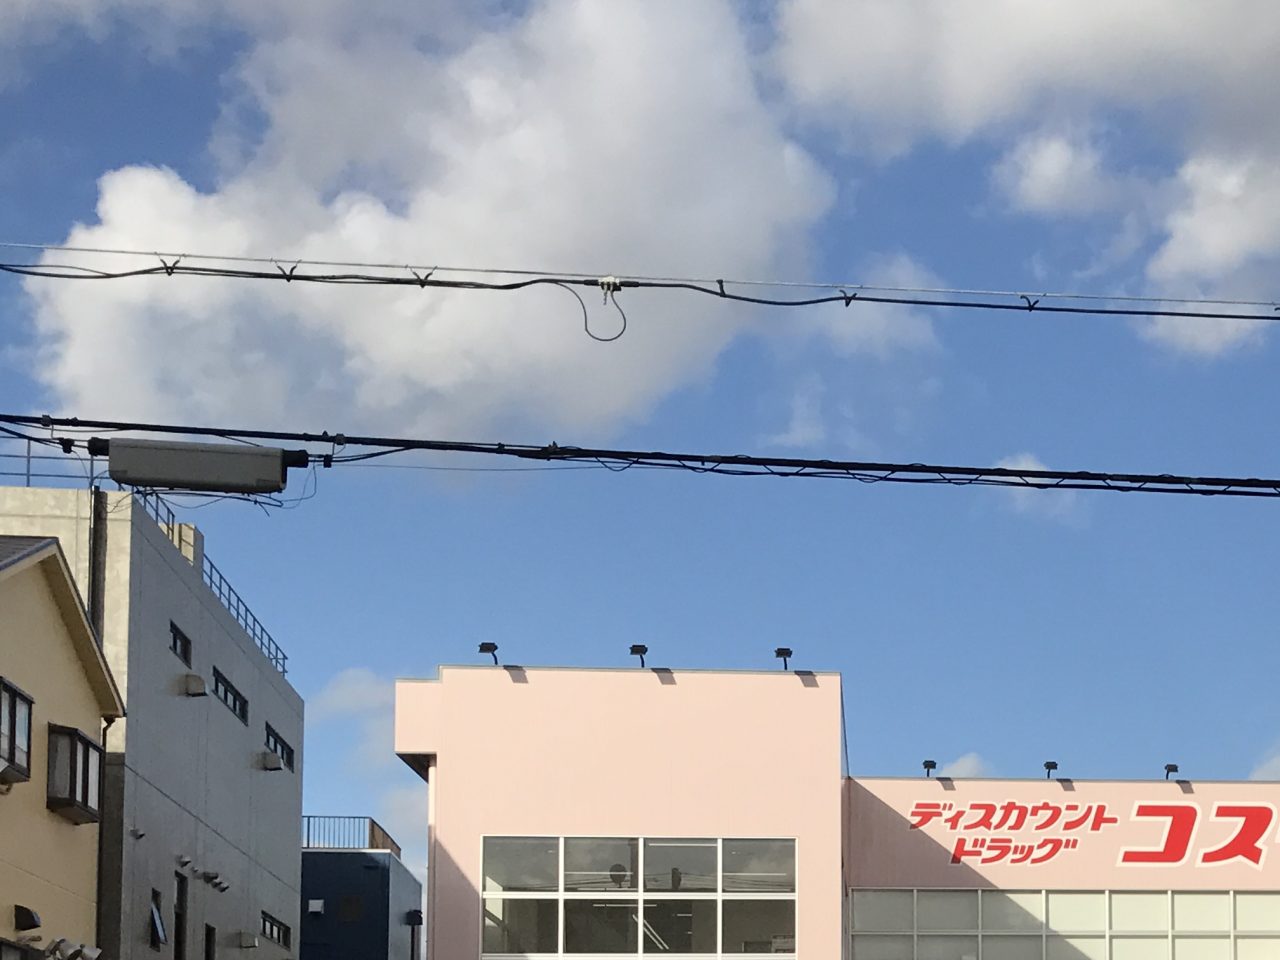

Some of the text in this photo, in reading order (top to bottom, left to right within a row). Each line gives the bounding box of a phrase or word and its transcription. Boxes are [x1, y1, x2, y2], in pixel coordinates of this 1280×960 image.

[909, 801, 1118, 832] ディスカウント
[950, 838, 1079, 865] ドラッグ
